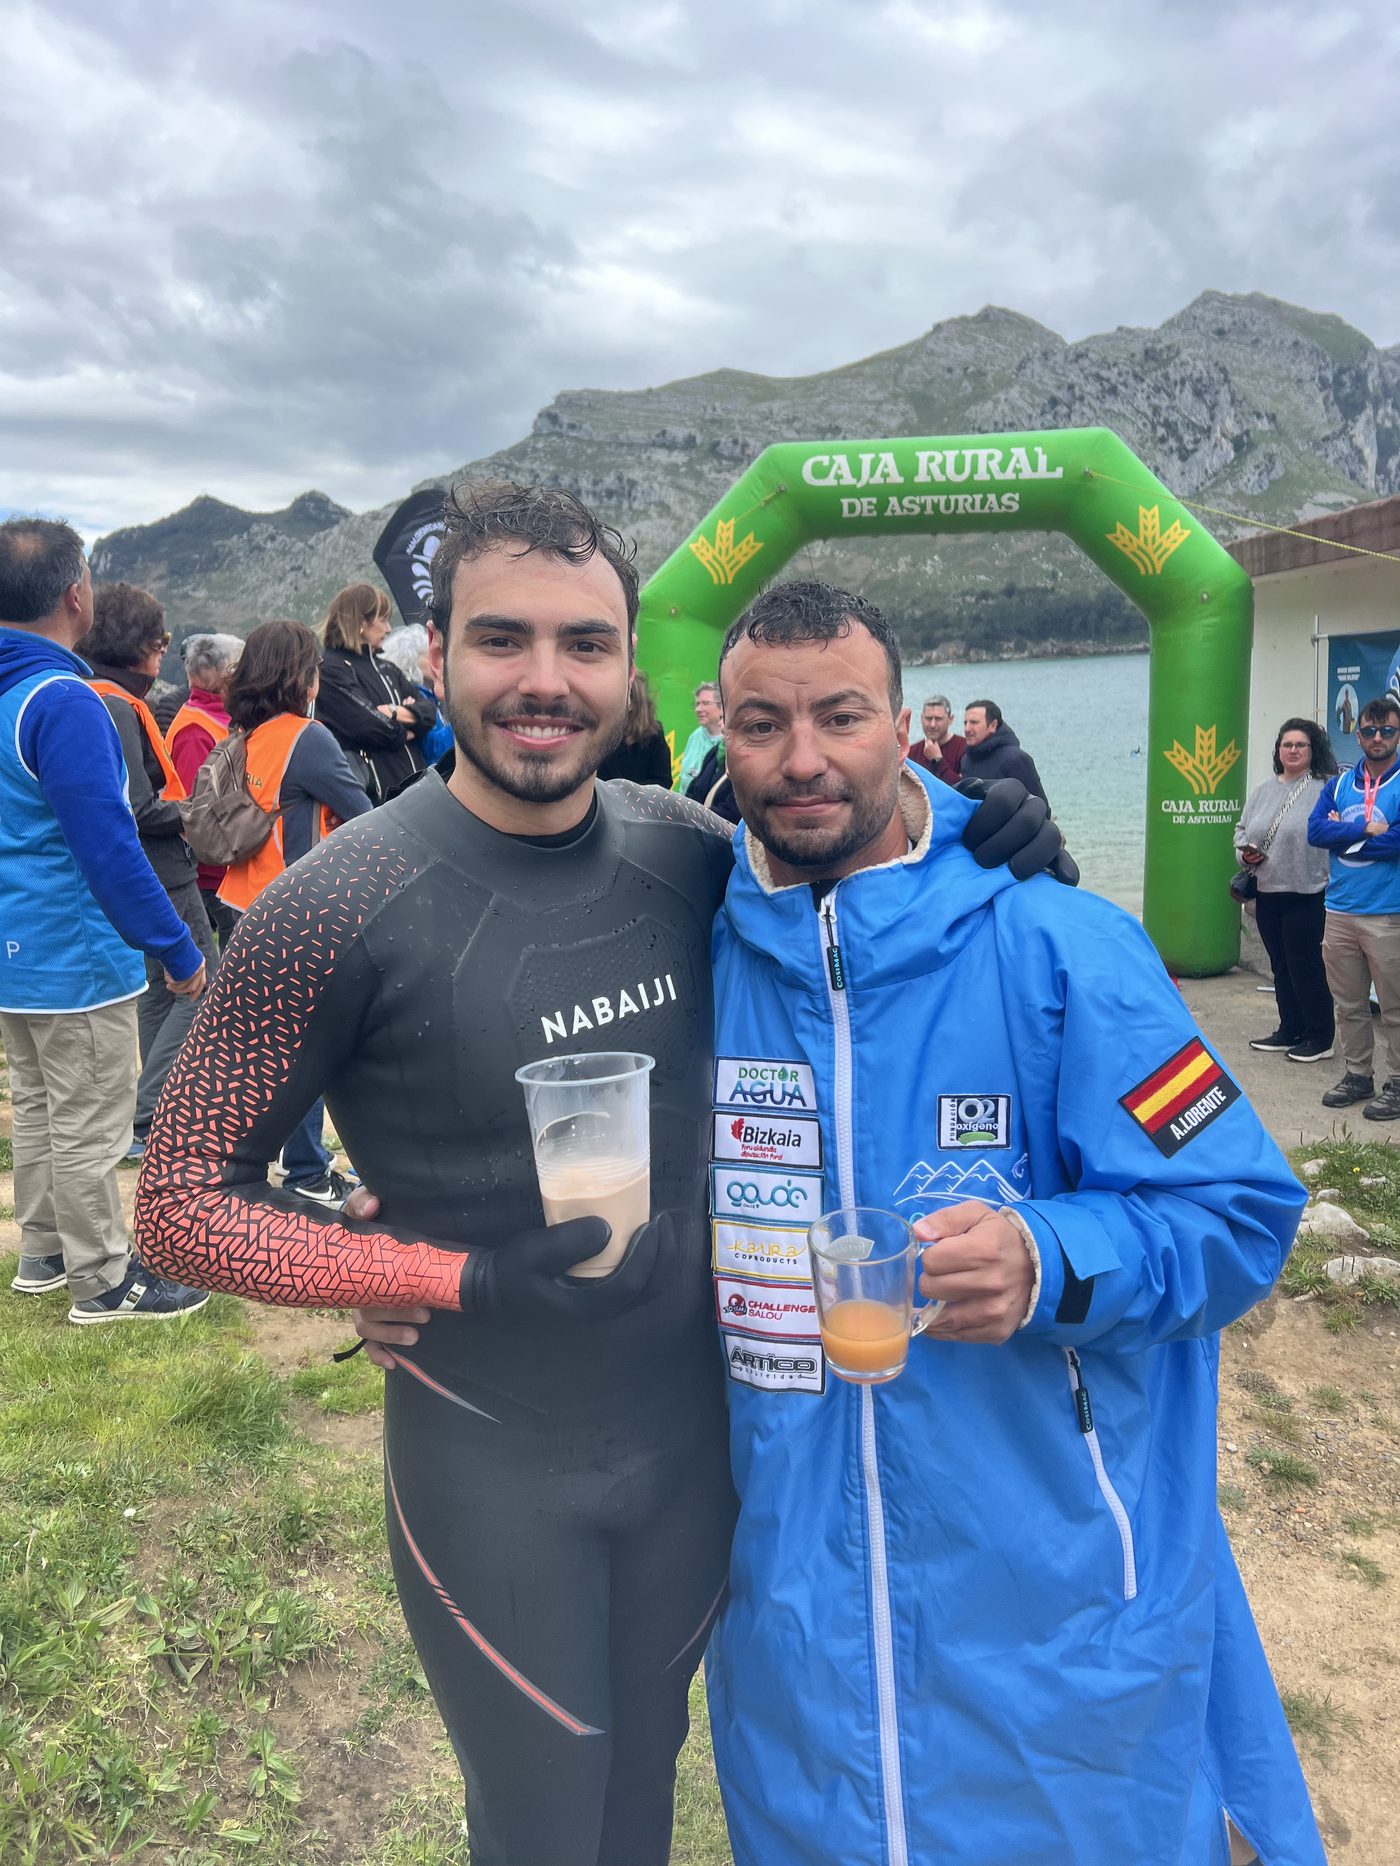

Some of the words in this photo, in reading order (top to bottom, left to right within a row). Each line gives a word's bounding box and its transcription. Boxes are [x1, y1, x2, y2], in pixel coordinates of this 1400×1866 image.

[801, 452, 904, 488] CAJA
[914, 446, 1063, 483] RURAL
[840, 497, 877, 518] DE
[884, 492, 1020, 517] ASTURIAS
[1161, 799, 1195, 814] CAJA
[1198, 799, 1240, 813] RURAL
[1172, 815, 1185, 824] DE
[1187, 815, 1232, 824] ASTURIAS
[6, 941, 20, 959] P
[832, 947, 843, 988] COSIMAC
[540, 973, 677, 1044] NABAIJI
[728, 1080, 808, 1108] AGUA
[742, 1126, 802, 1148] Bizkaia
[734, 1252, 798, 1265] COPRODUCTS
[747, 1300, 816, 1313] CHALLENGE
